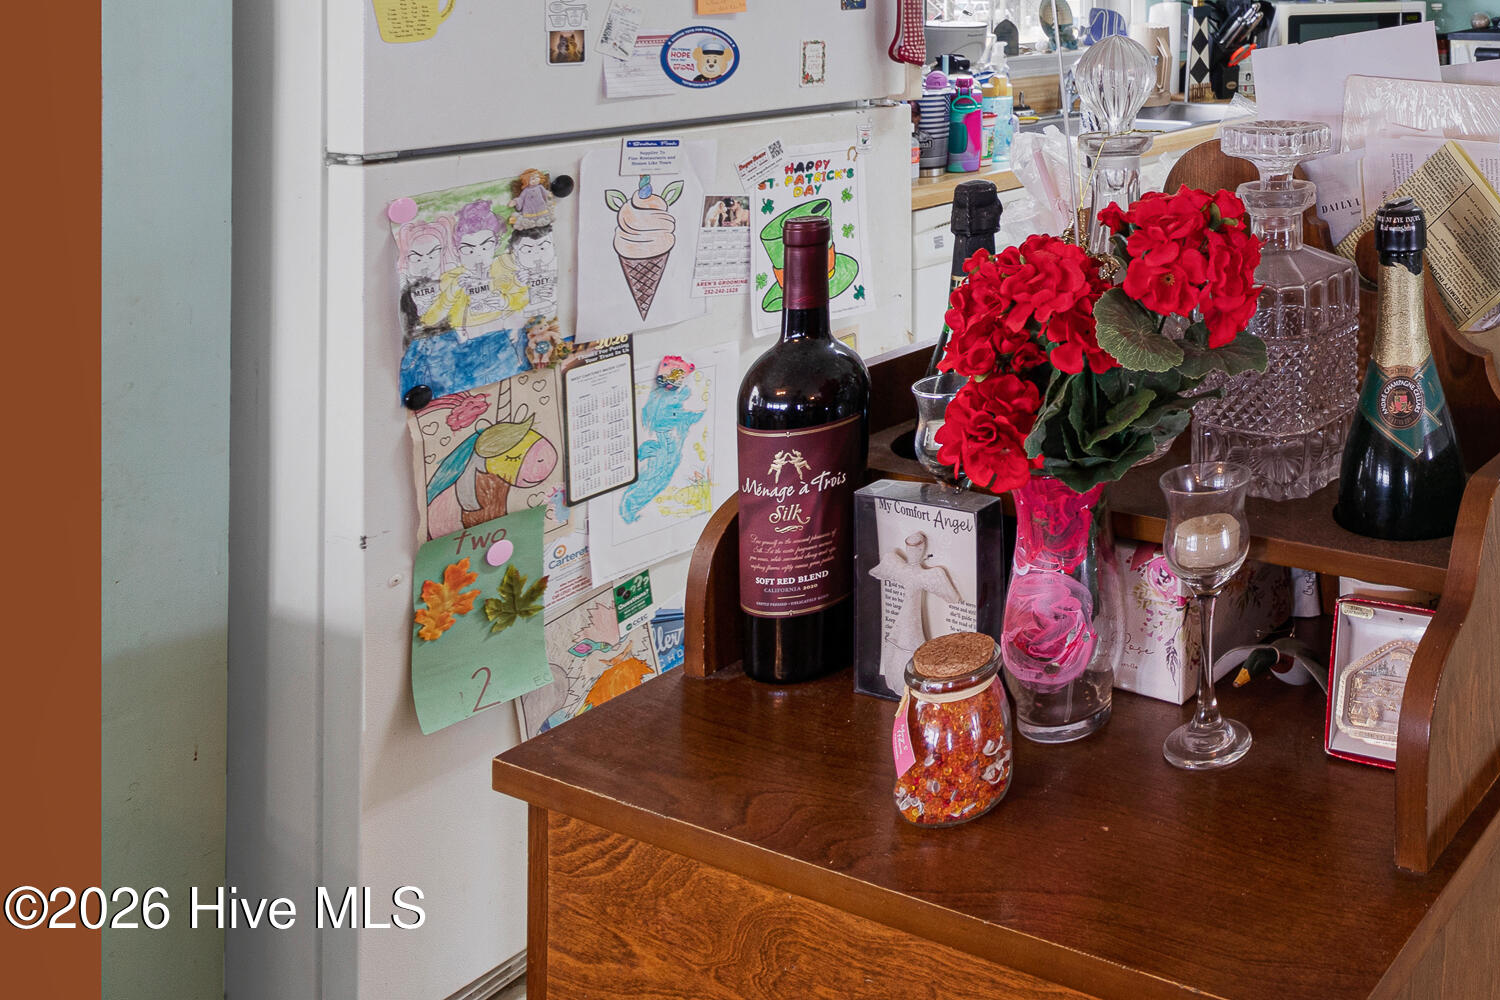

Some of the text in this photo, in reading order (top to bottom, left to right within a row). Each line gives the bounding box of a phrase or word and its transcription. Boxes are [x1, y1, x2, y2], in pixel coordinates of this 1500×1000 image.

[670, 51, 691, 59] HOPE
[785, 159, 831, 175] HAPPY
[784, 168, 855, 187] PATRICK'S
[793, 184, 822, 198] DAY
[1321, 199, 1352, 214] DAILY
[469, 285, 491, 295] RUMI
[530, 278, 550, 288] ZOEY
[413, 286, 436, 298] MIRA
[1384, 379, 1416, 394] CHAMPAGNE
[742, 470, 847, 503] Ménage à Trois
[768, 503, 811, 524] Silk
[879, 499, 974, 535] My Comfort Angel
[453, 528, 507, 555] two
[755, 570, 829, 586] SOFT RED BLEND
[802, 583, 818, 591] 2020
[471, 666, 501, 713] 2
